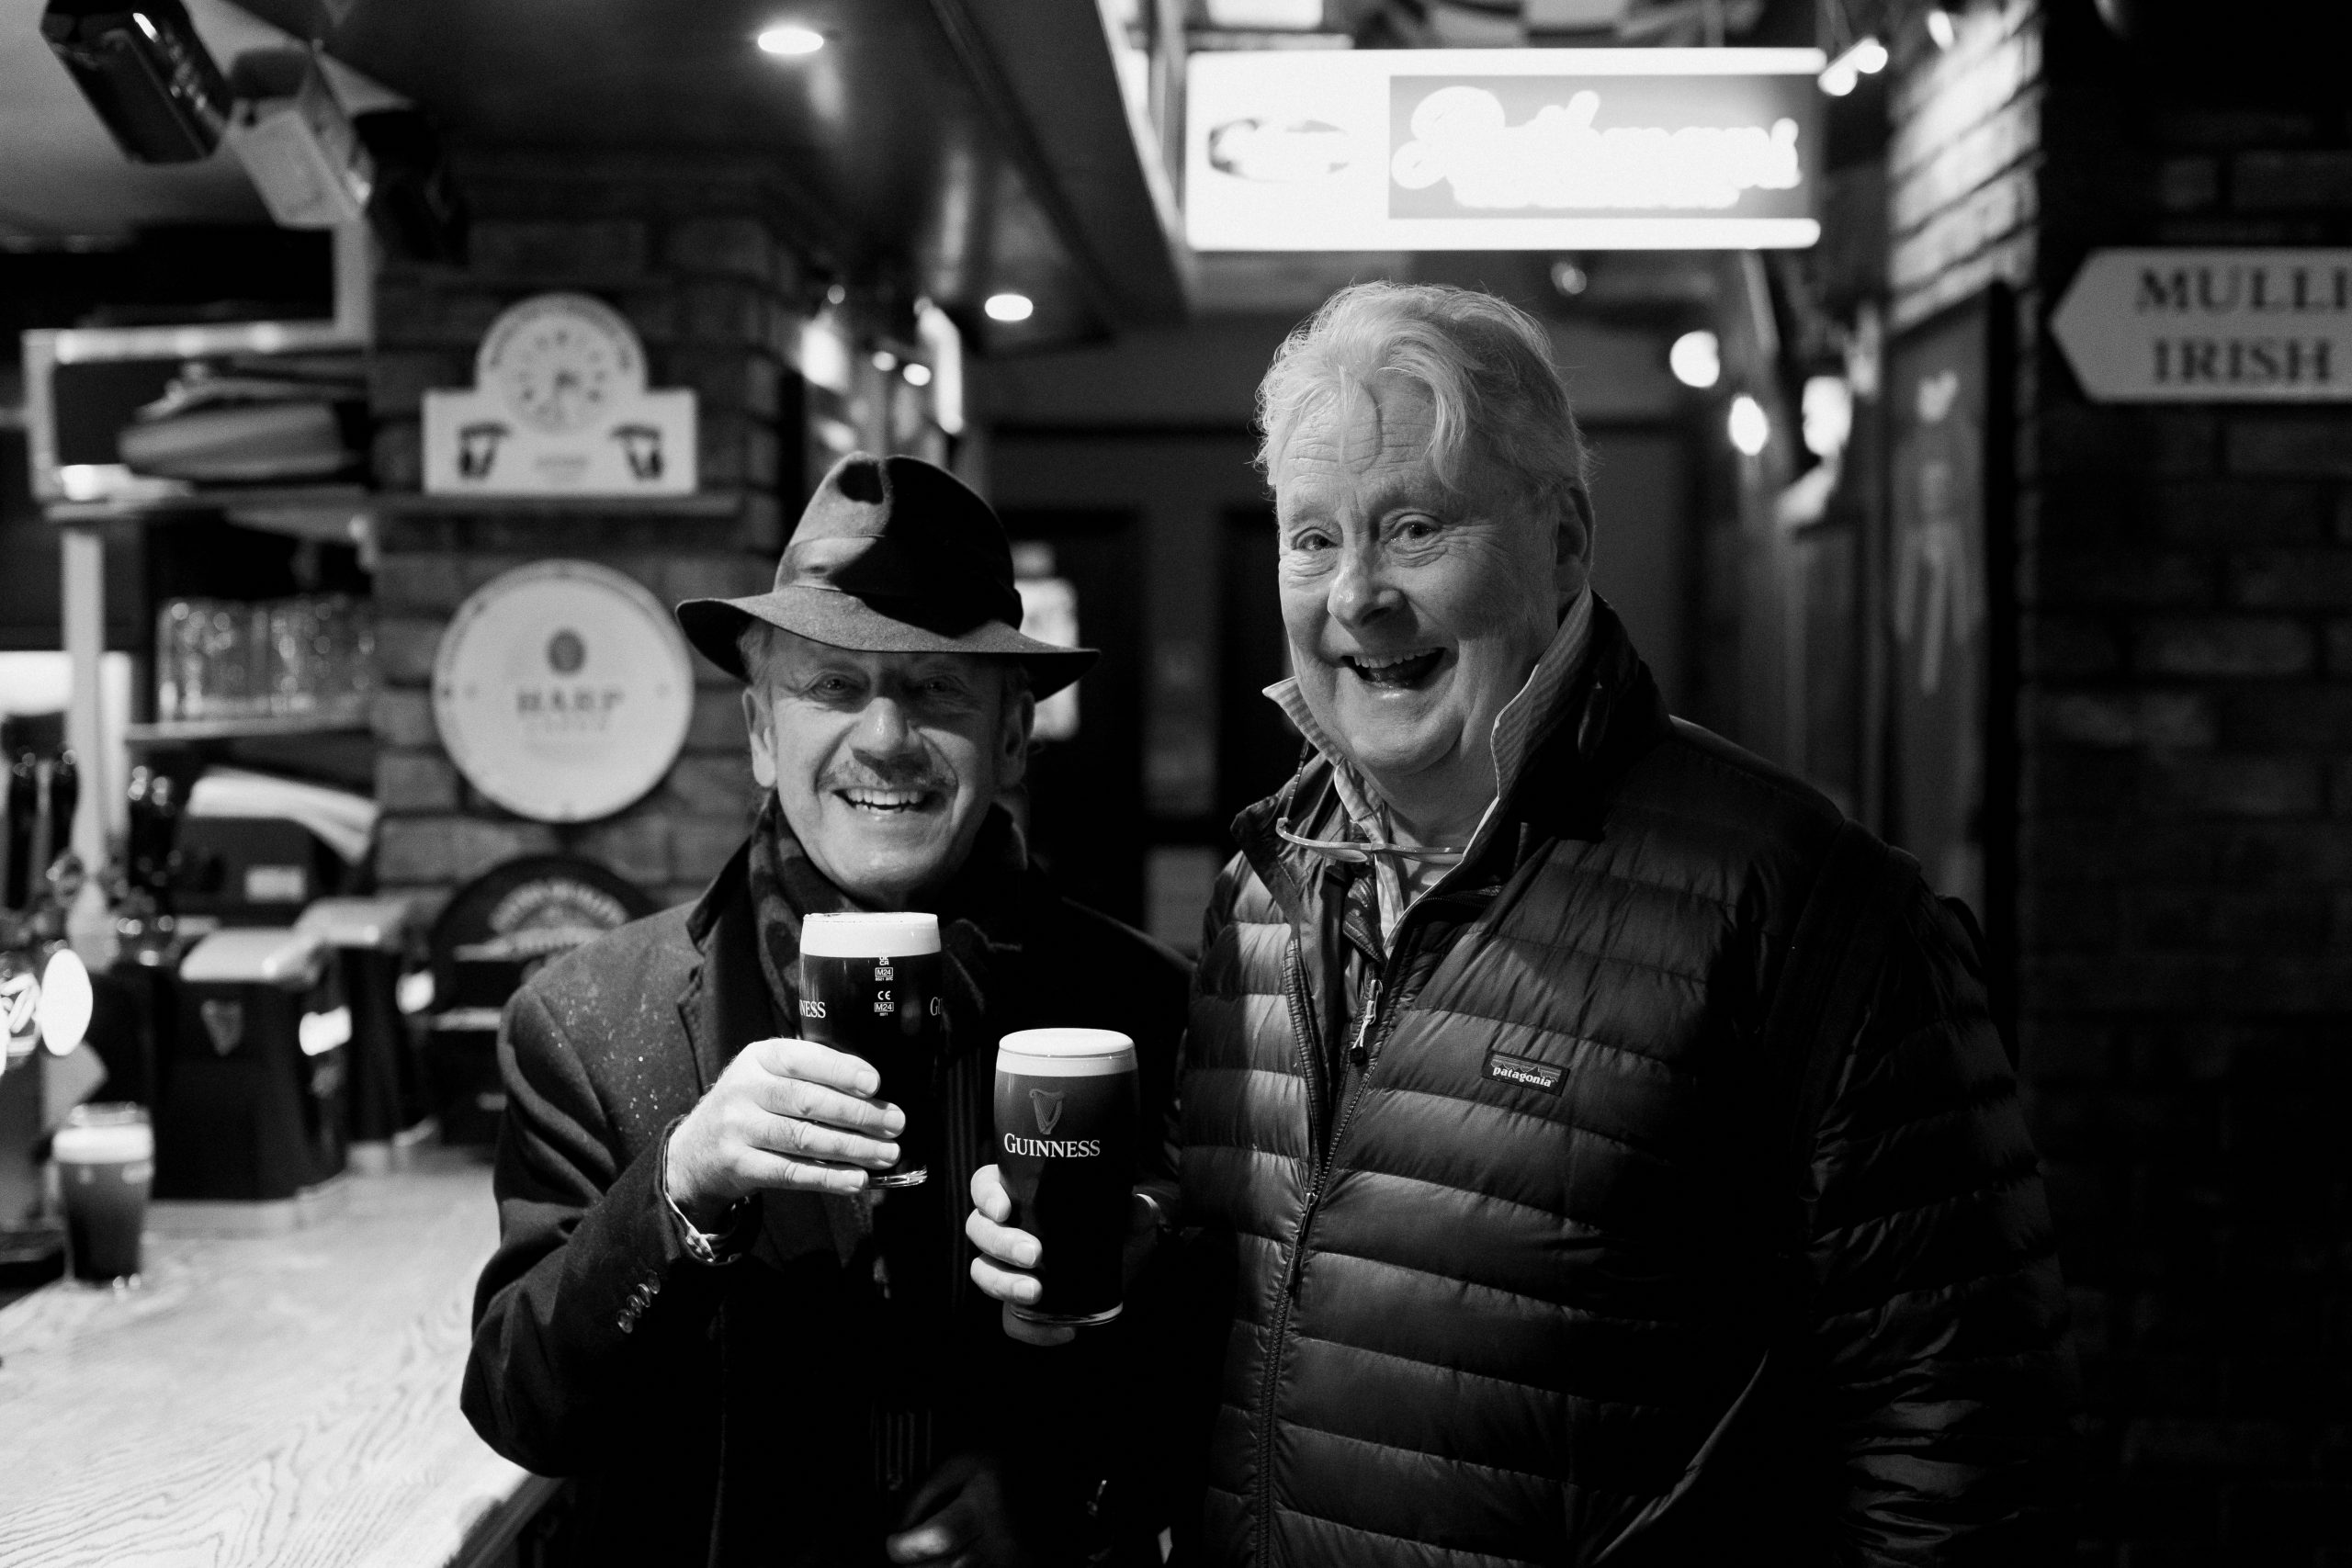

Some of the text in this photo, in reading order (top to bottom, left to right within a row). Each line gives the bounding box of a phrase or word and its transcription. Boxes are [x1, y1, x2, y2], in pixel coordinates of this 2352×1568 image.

[2154, 338, 2333, 383] IRISH
[877, 990, 891, 1000] CE
[1492, 1066, 1552, 1088] patagonia
[1004, 1133, 1101, 1157] GUINNESS
